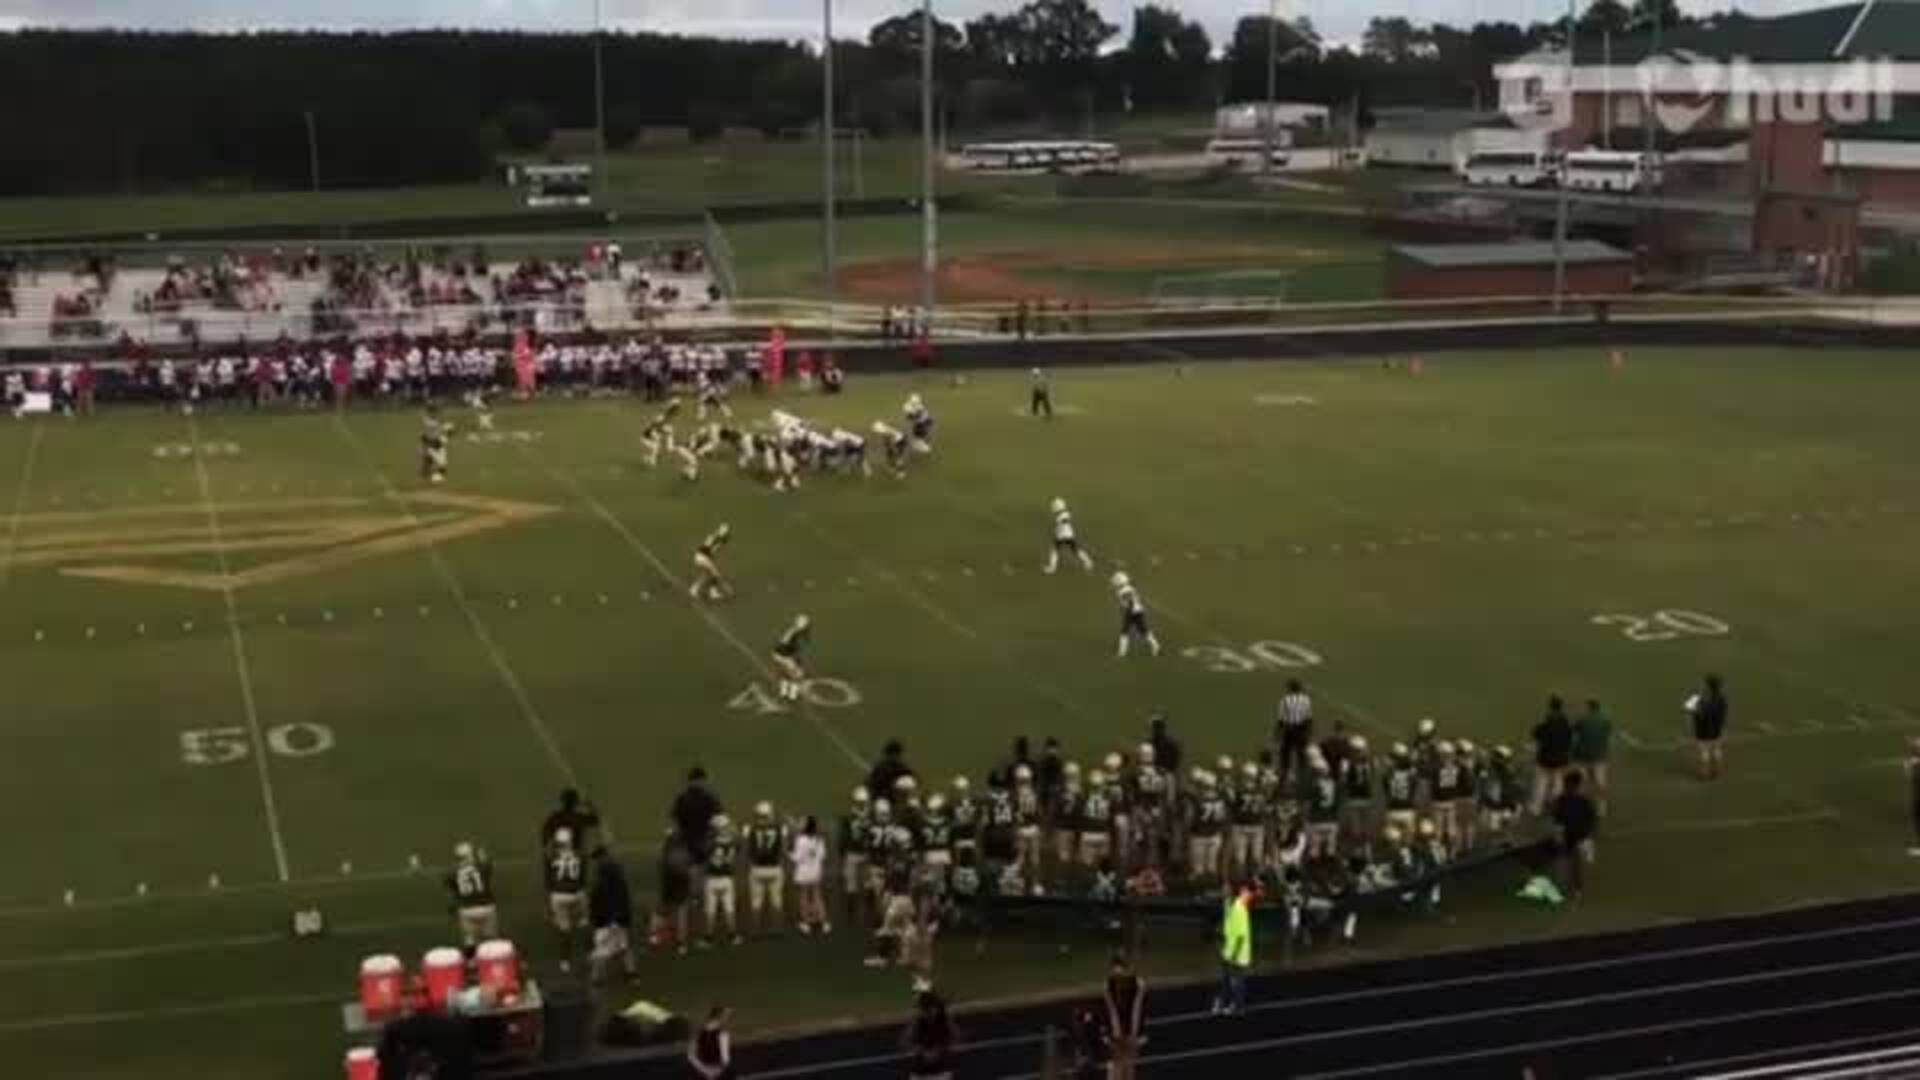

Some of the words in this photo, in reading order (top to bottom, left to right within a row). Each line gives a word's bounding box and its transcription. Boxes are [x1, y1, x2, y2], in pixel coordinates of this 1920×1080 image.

[1591, 607, 1730, 641] 20
[1180, 638, 1322, 673] 30
[727, 676, 861, 713] 40
[180, 722, 335, 764] 50
[756, 829, 777, 849] 17
